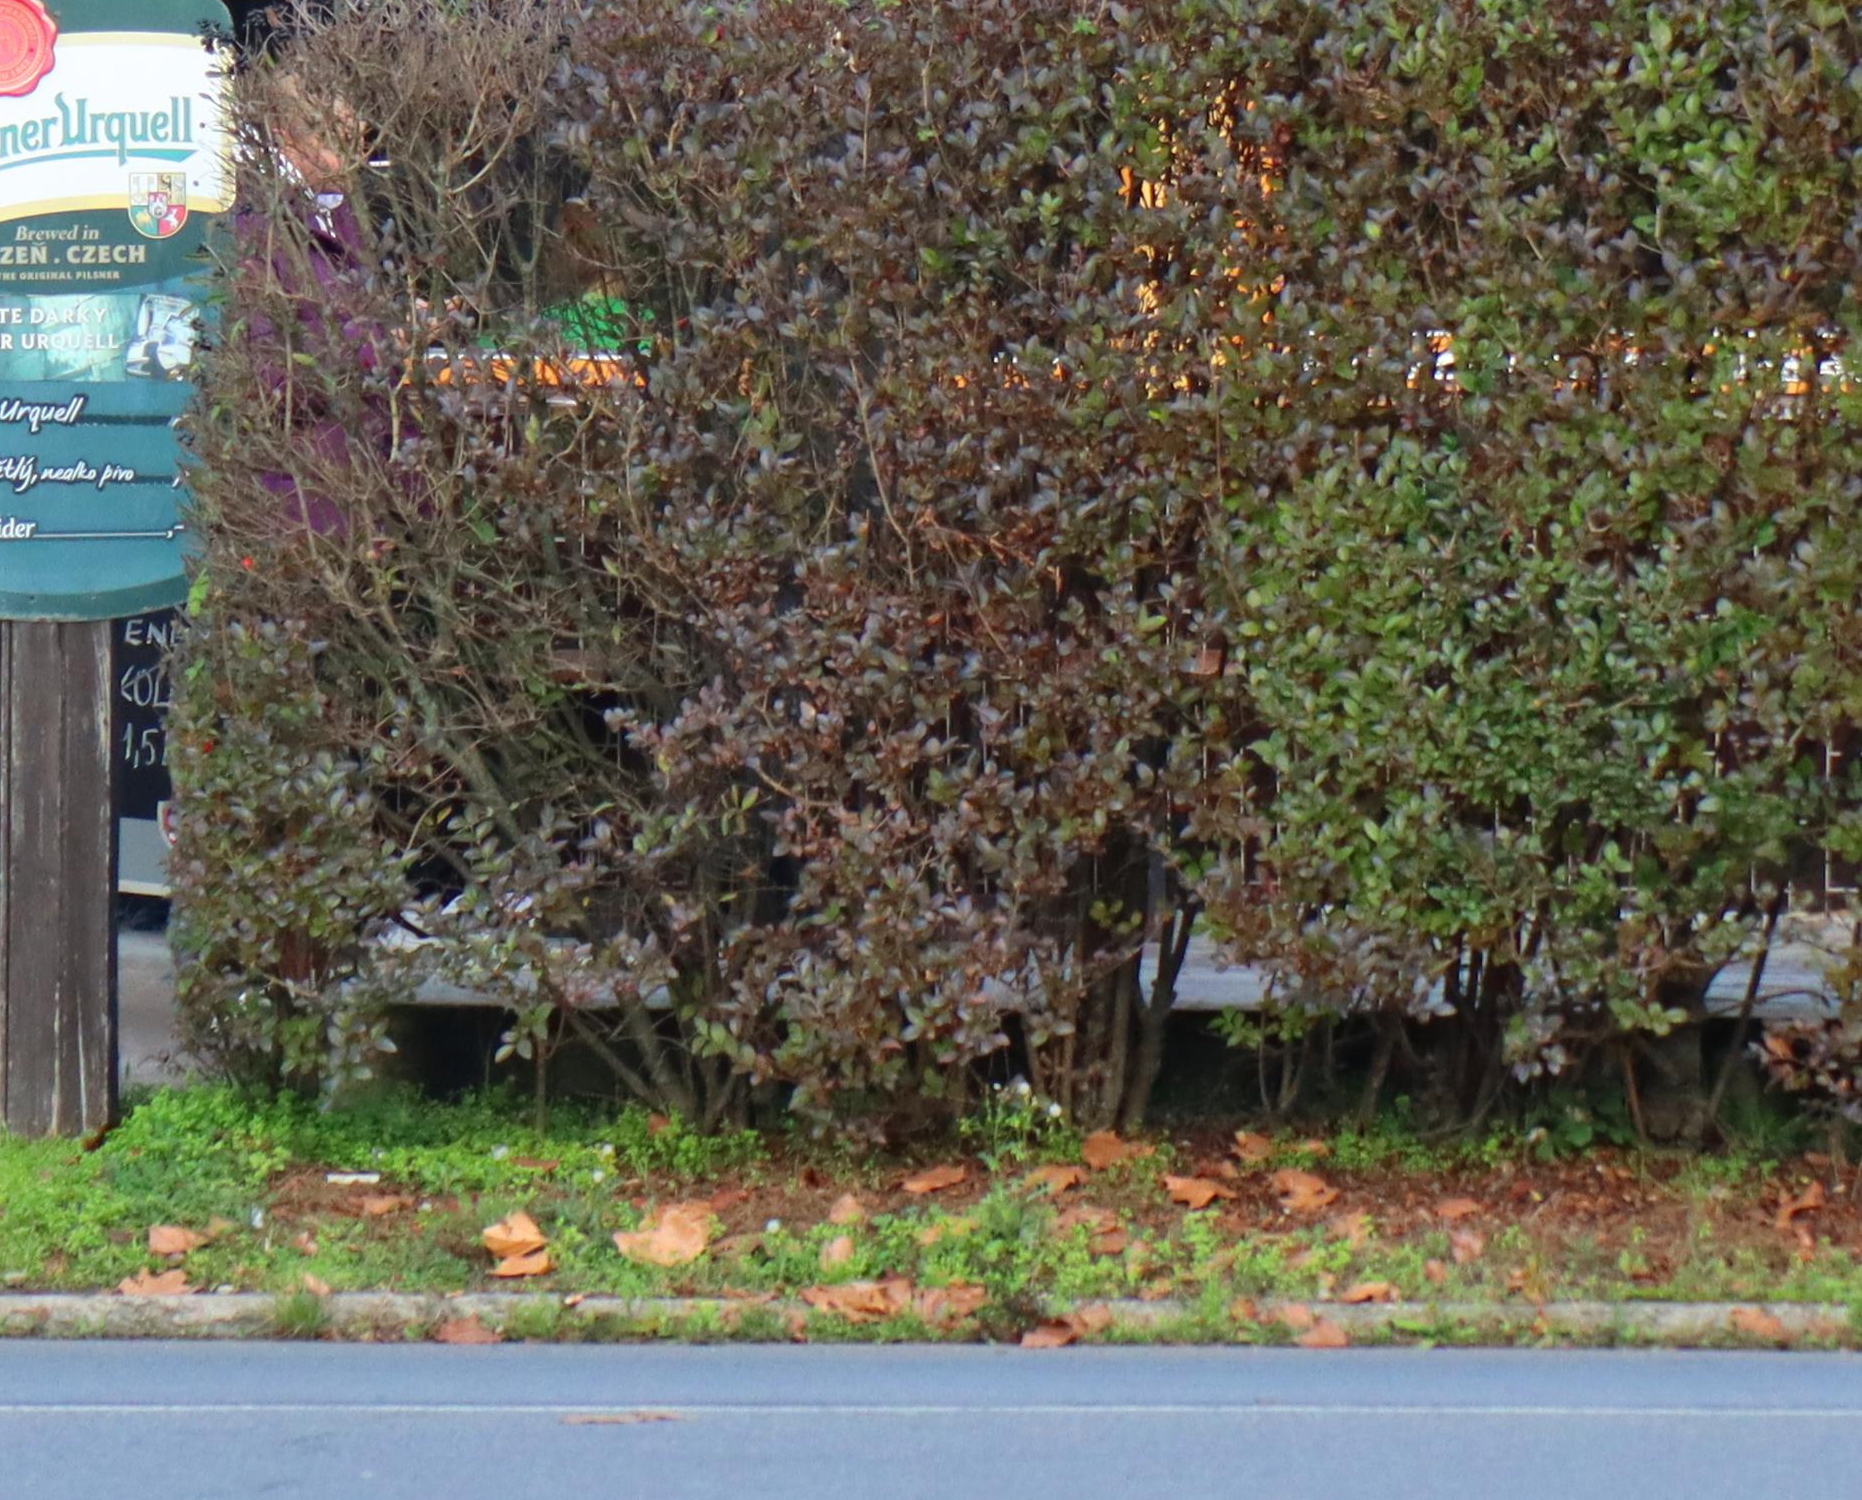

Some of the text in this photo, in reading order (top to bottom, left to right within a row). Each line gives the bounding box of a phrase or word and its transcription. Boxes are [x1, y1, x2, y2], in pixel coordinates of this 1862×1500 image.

[55, 92, 193, 166] Urquell
[15, 225, 100, 241] Brewed in
[66, 244, 146, 264] CZECH
[19, 271, 72, 280] ORIGINAL
[76, 270, 120, 280] PILSNER
[21, 332, 120, 349] URQUELL
[40, 461, 96, 480] nealko
[99, 466, 134, 488] pivo
